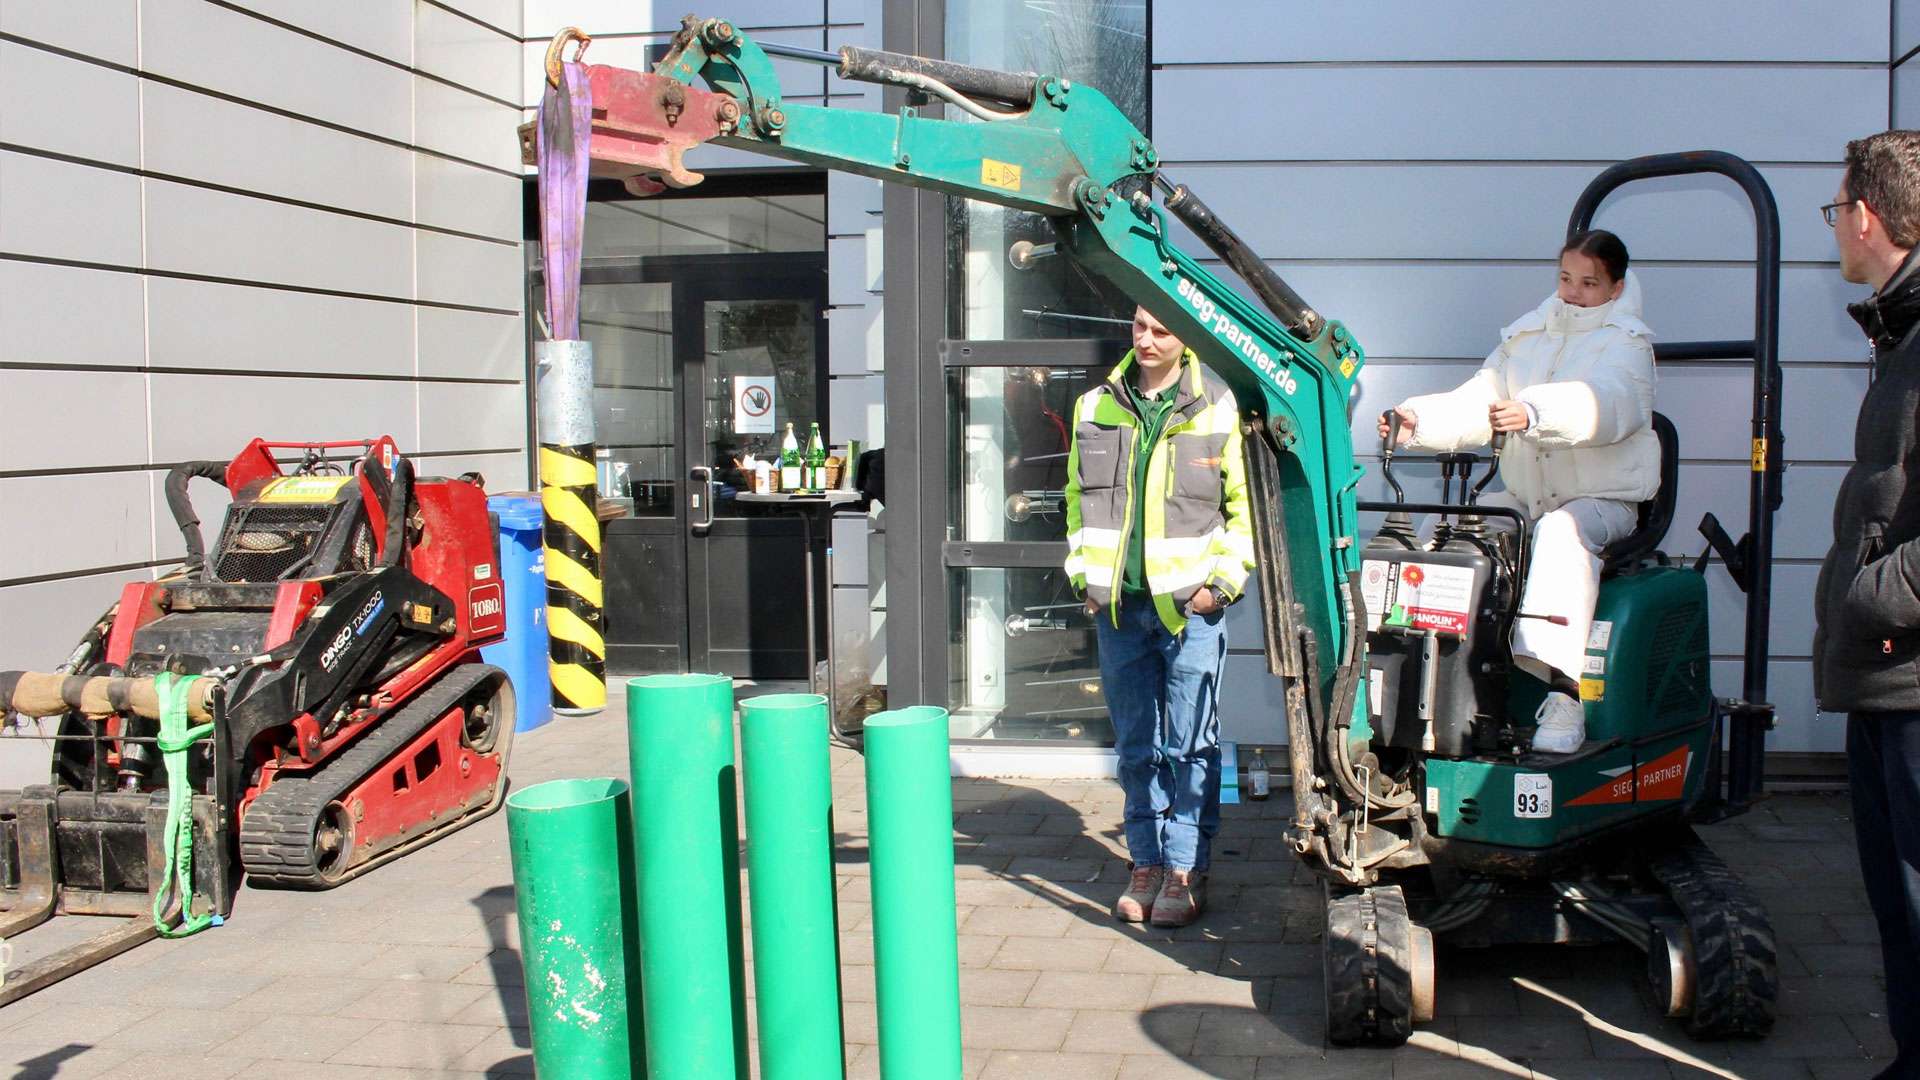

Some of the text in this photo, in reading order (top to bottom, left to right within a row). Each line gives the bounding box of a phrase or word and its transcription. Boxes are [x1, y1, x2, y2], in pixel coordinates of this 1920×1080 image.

[1177, 278, 1297, 396] sieg-partner.de
[321, 626, 351, 668] DINGO
[1613, 779, 1633, 797] SIEG
[1643, 764, 1682, 787] PARTNER
[1517, 793, 1549, 813] 93 dB
